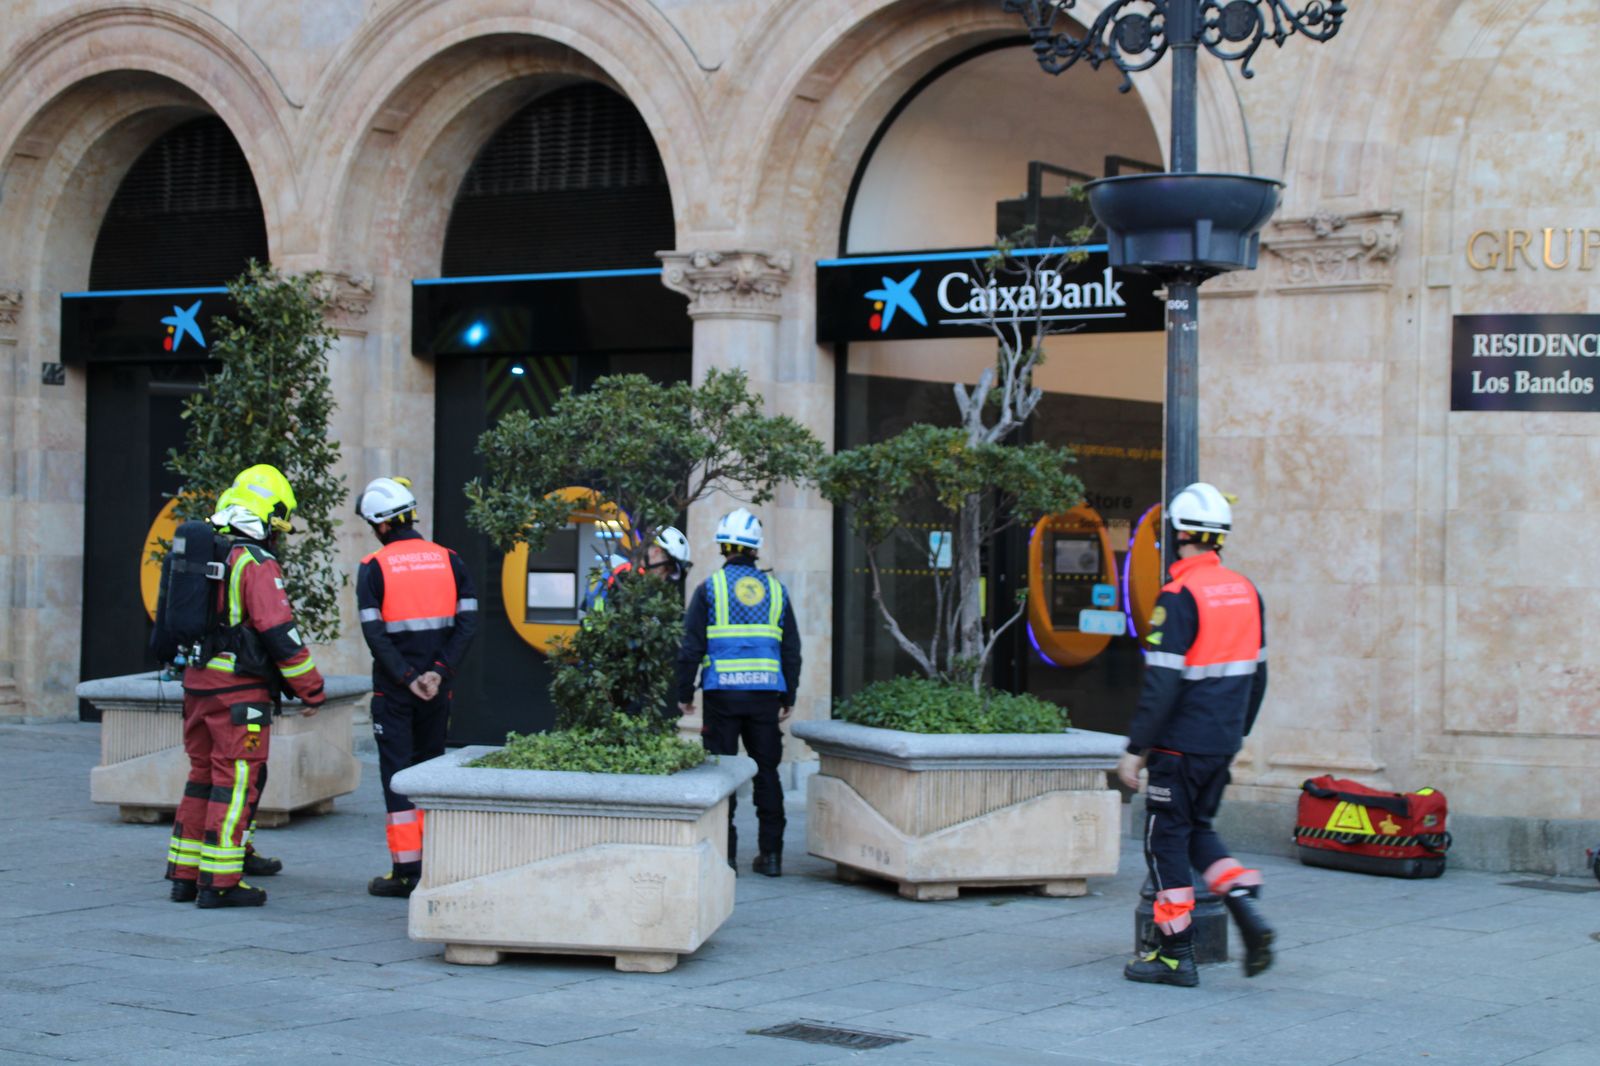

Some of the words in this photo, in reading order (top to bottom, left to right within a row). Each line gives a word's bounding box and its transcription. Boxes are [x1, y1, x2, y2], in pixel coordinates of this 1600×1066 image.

[937, 266, 1127, 313] CaixaBank
[1471, 370, 1509, 394] Los
[1514, 369, 1594, 395] Bandos
